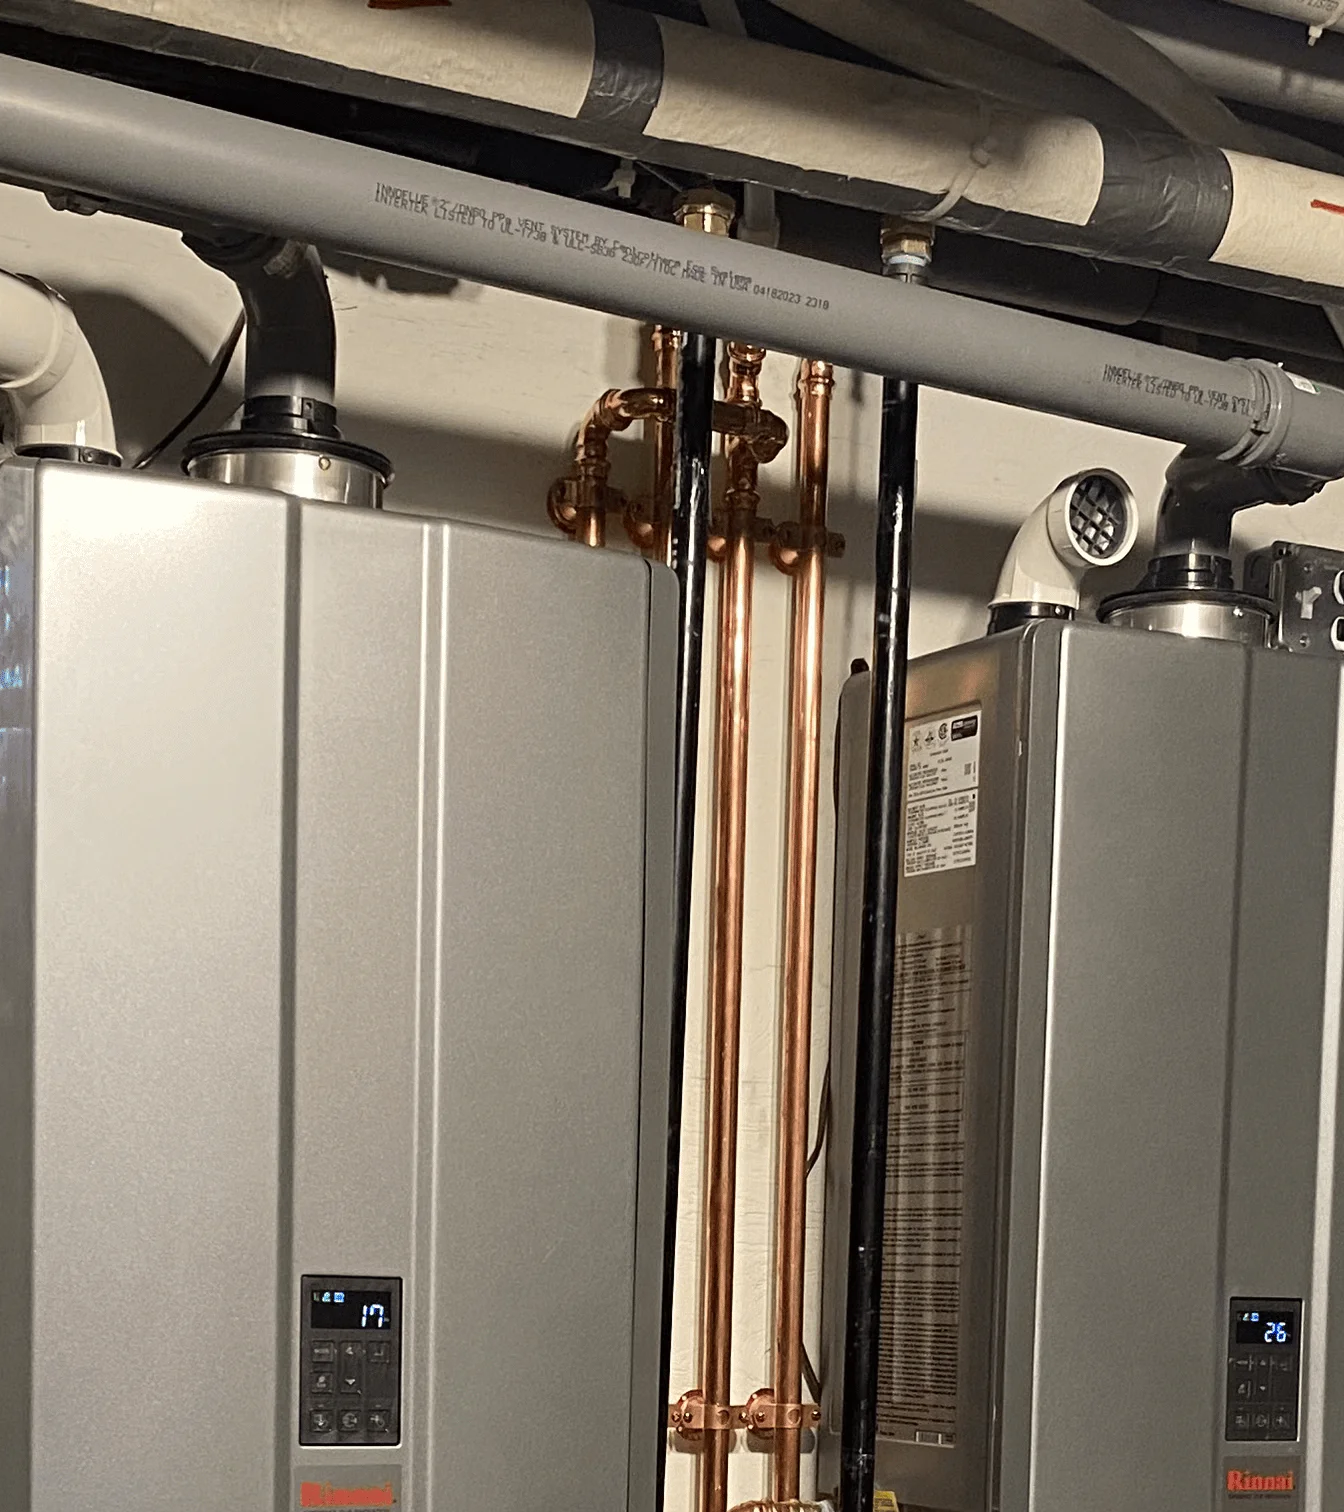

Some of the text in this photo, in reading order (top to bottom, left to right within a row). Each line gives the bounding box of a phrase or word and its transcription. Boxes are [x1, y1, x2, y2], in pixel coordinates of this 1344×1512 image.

[361, 1303, 384, 1328] 17
[1264, 1321, 1287, 1343] 26
[1227, 1469, 1294, 1491] Rinnai
